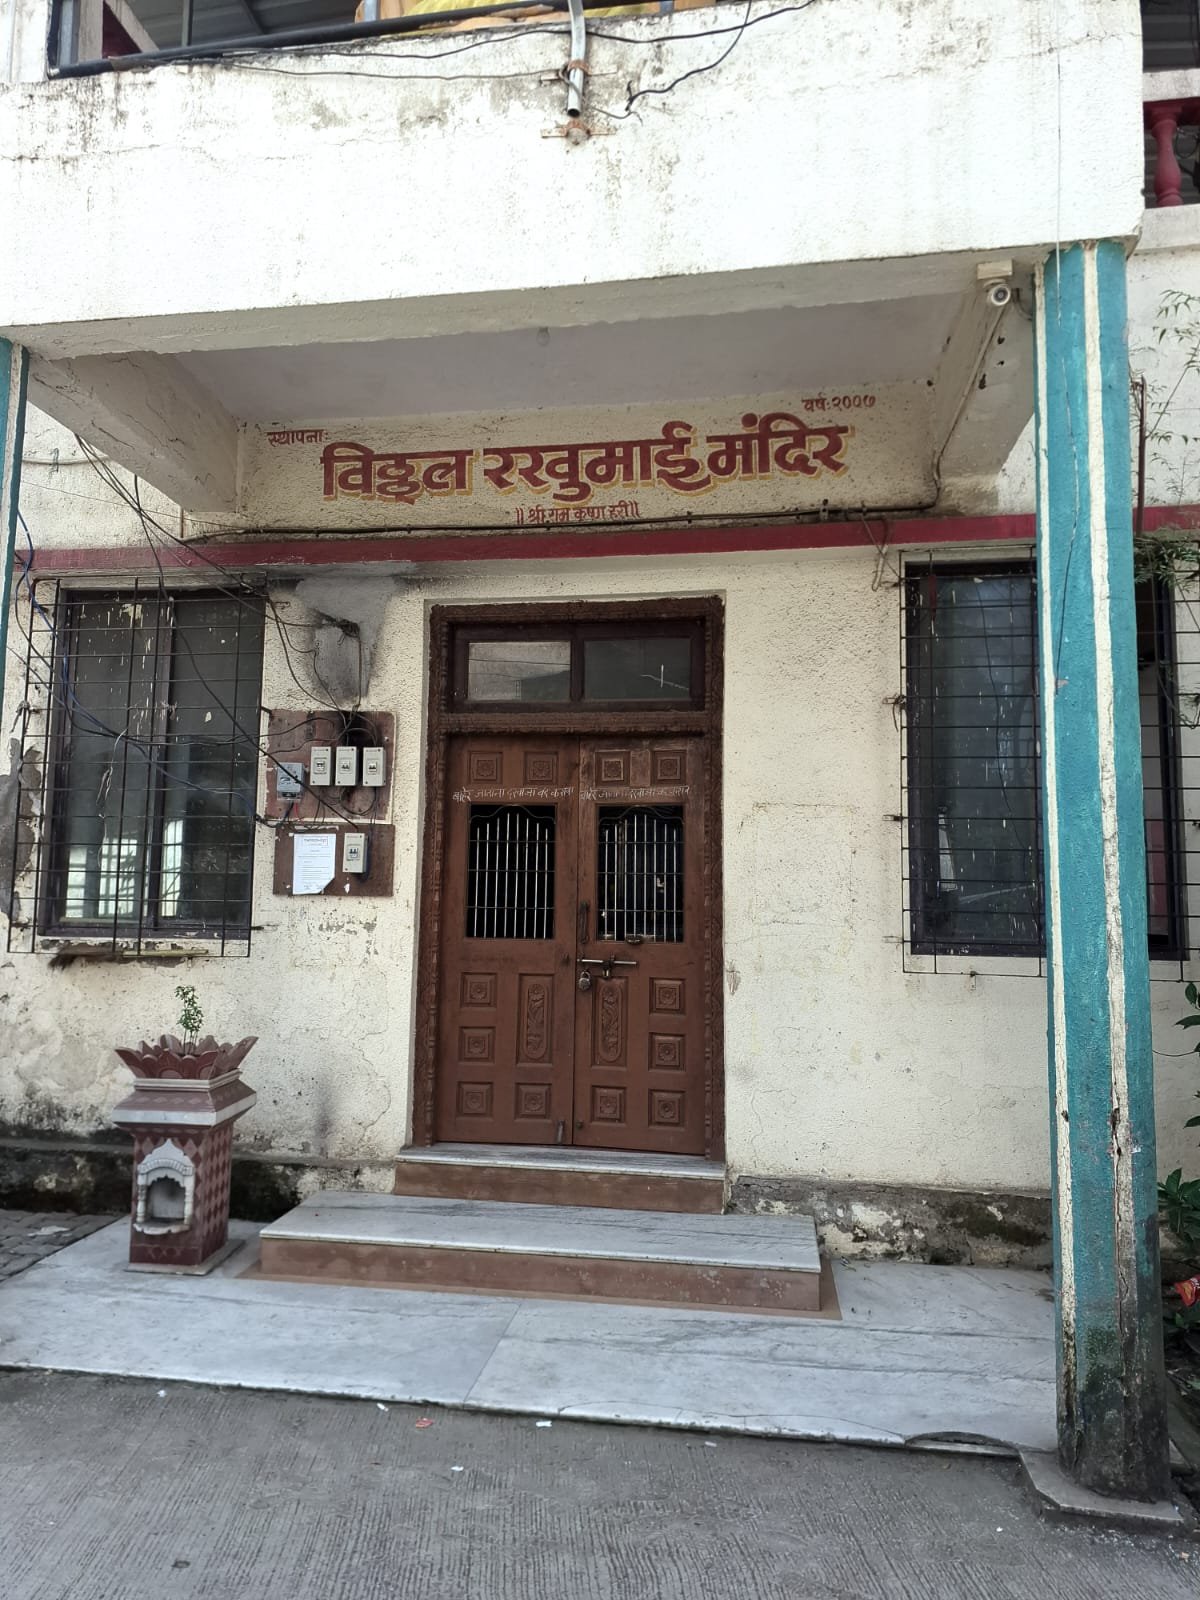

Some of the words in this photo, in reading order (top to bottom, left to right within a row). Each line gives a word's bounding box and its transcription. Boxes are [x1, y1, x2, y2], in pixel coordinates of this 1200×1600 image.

[319, 440, 474, 505] विठ्ठल
[483, 420, 711, 504] रखुमाई
[705, 411, 851, 477] मंदिर
